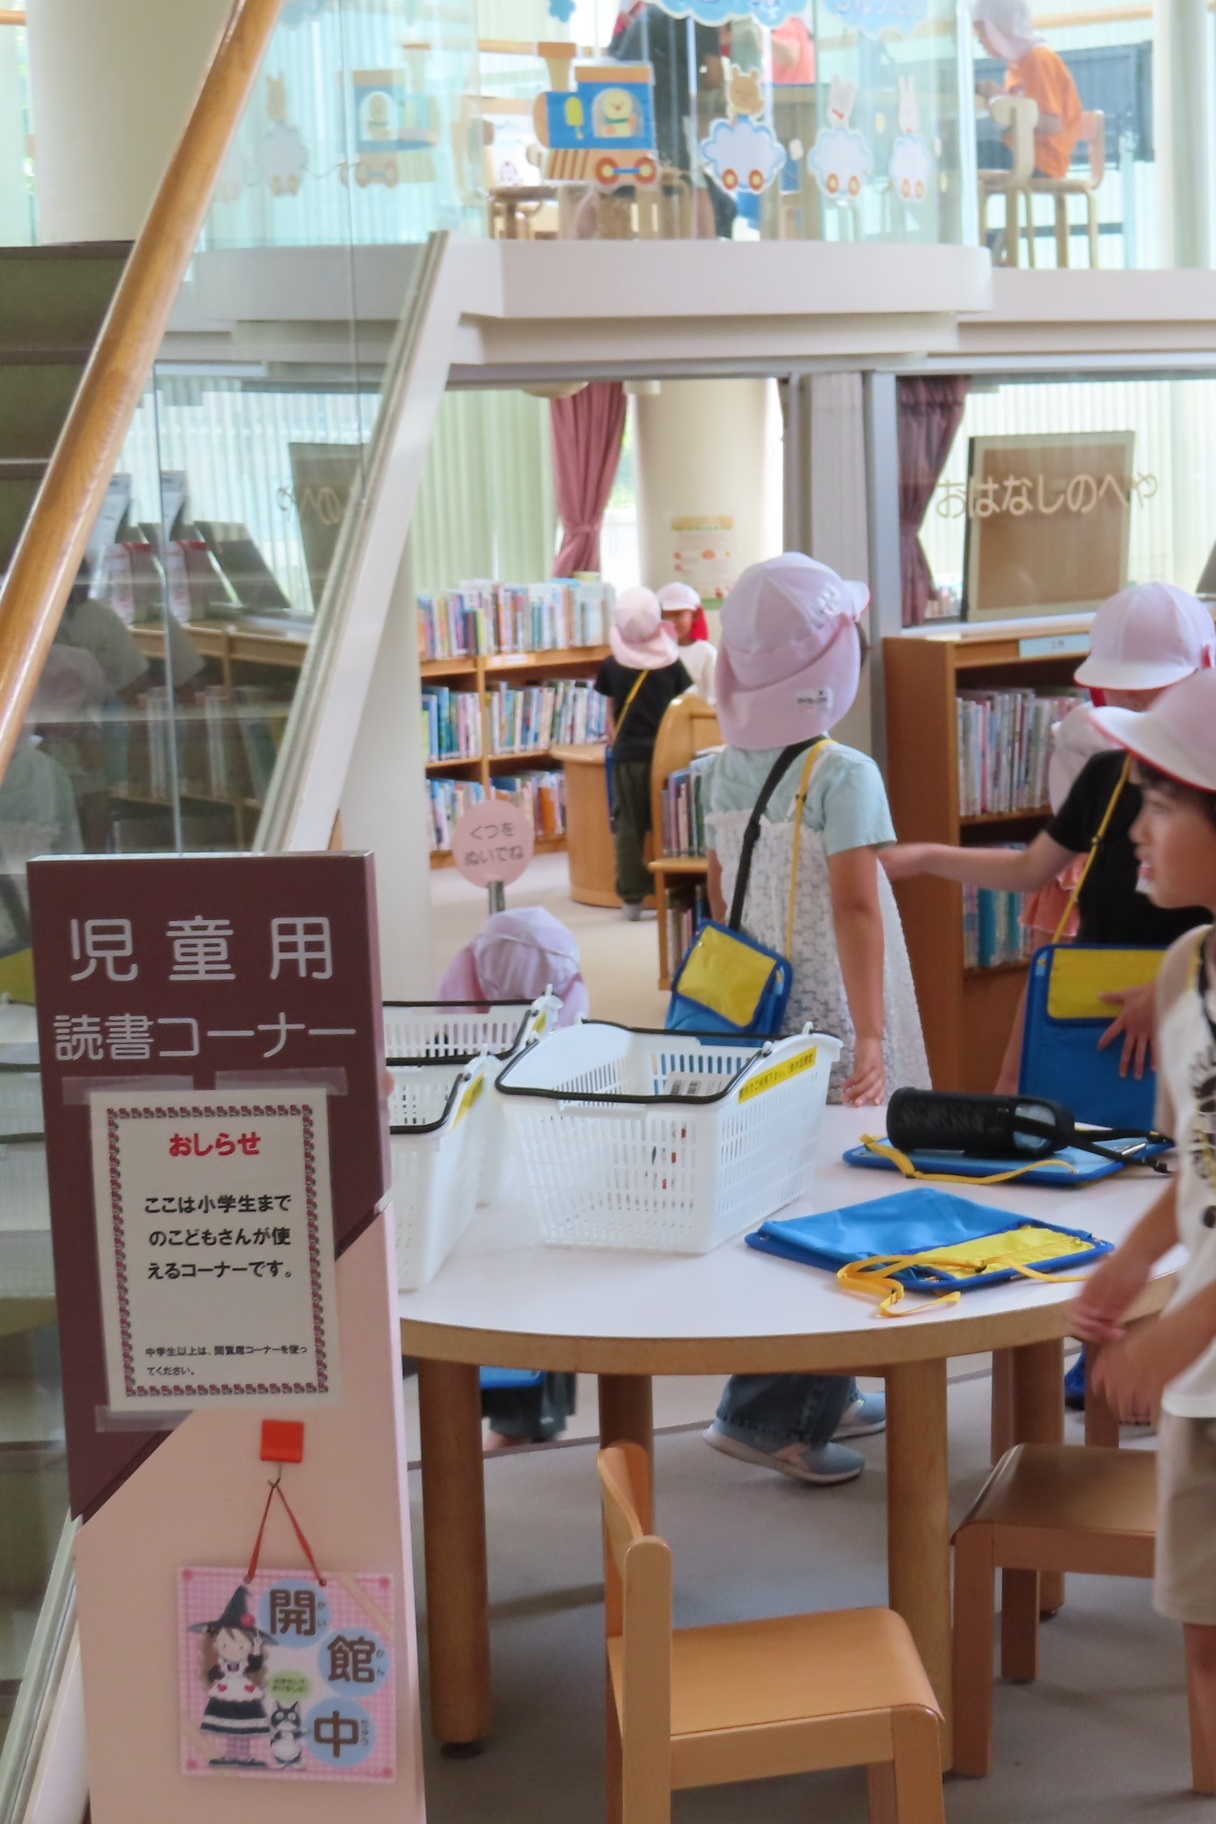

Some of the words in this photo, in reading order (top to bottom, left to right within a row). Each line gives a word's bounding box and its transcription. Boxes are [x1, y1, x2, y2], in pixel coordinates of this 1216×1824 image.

[935, 470, 1159, 519] おはなしのへや
[470, 822, 515, 841] くつを
[464, 845, 524, 867] ぬいでね
[70, 915, 334, 982] 児童用
[53, 1012, 356, 1062] 読書コーナー
[169, 1132, 262, 1158] おしらせ
[145, 1195, 292, 1214] ここは小学生まで
[149, 1226, 291, 1246] のこどもさんが使
[147, 1260, 293, 1280] えるコーナーです。
[147, 1366, 195, 1377] てください。
